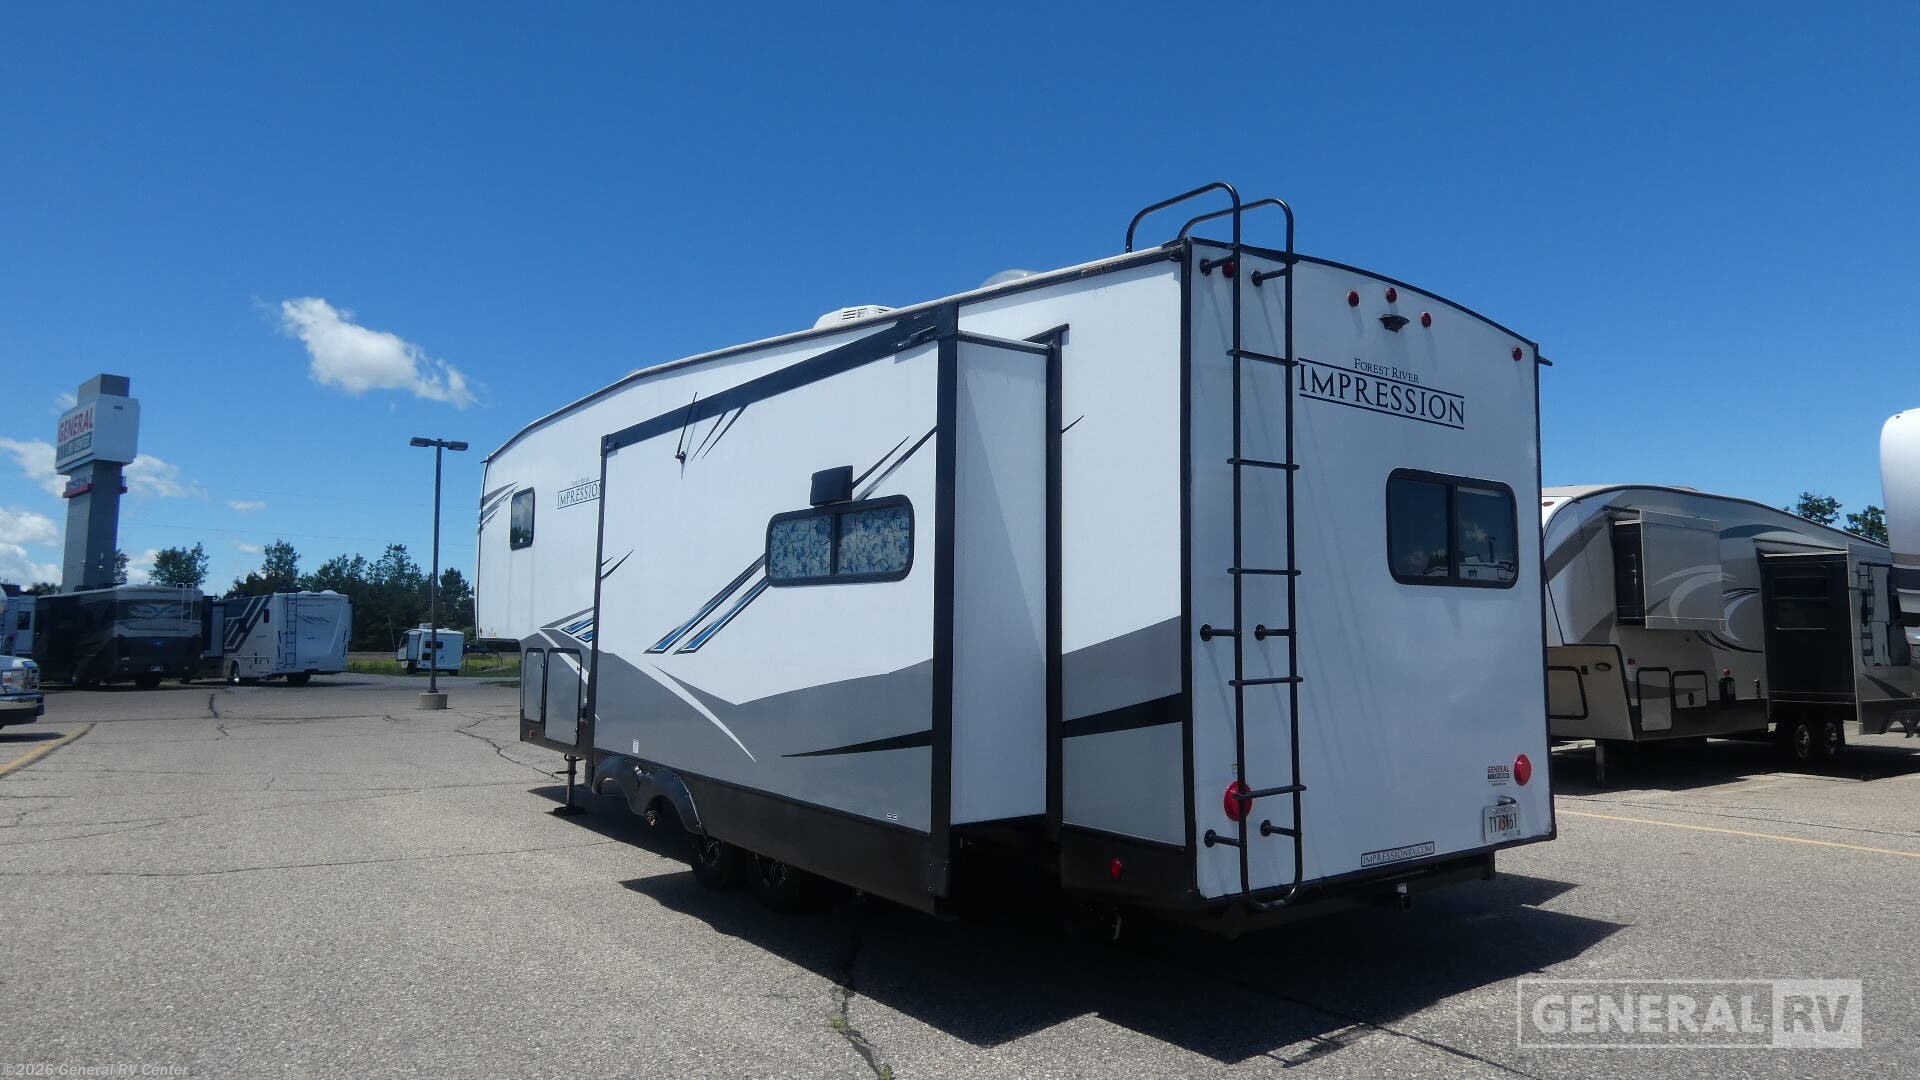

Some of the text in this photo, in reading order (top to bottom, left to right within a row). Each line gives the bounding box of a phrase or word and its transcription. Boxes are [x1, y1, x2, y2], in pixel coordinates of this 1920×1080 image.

[1354, 357, 1419, 384] FOREST RIVER
[1298, 363, 1465, 425] IMPRESSION
[59, 407, 93, 443] GENERAL
[557, 482, 601, 507] IMPRESSIO
